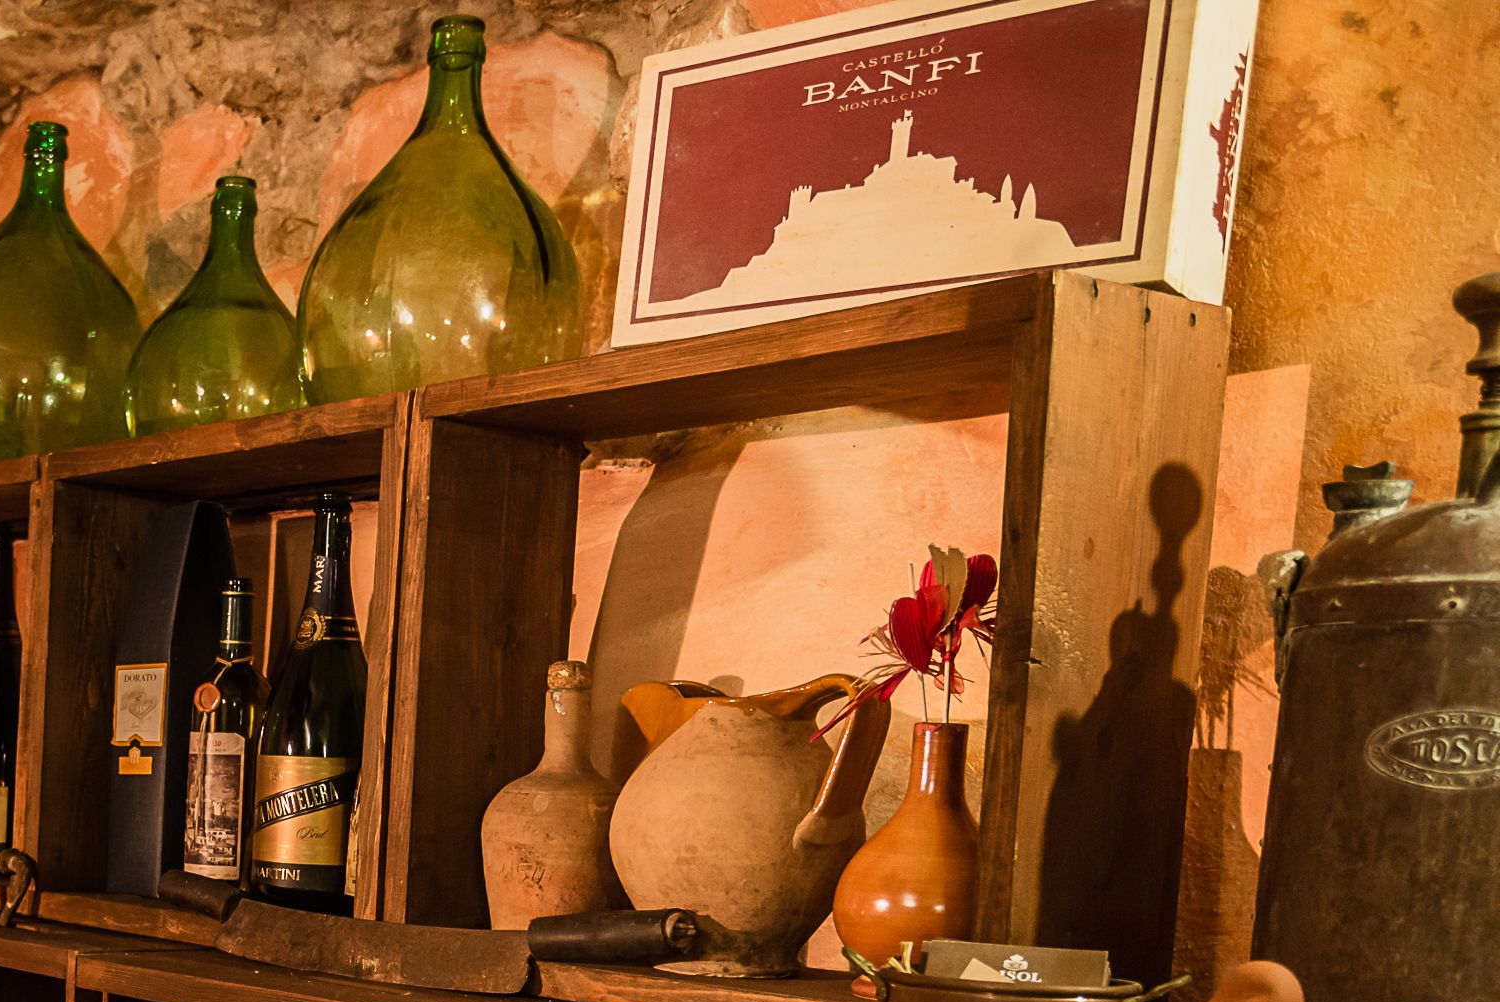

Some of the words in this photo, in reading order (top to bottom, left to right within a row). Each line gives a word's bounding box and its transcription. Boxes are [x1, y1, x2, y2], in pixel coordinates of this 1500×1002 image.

[801, 51, 984, 107] BANFI
[838, 87, 939, 113] MONTALCINO
[123, 673, 157, 683] DORATO
[266, 781, 340, 821] MONTELERA
[296, 826, 331, 841] Brut
